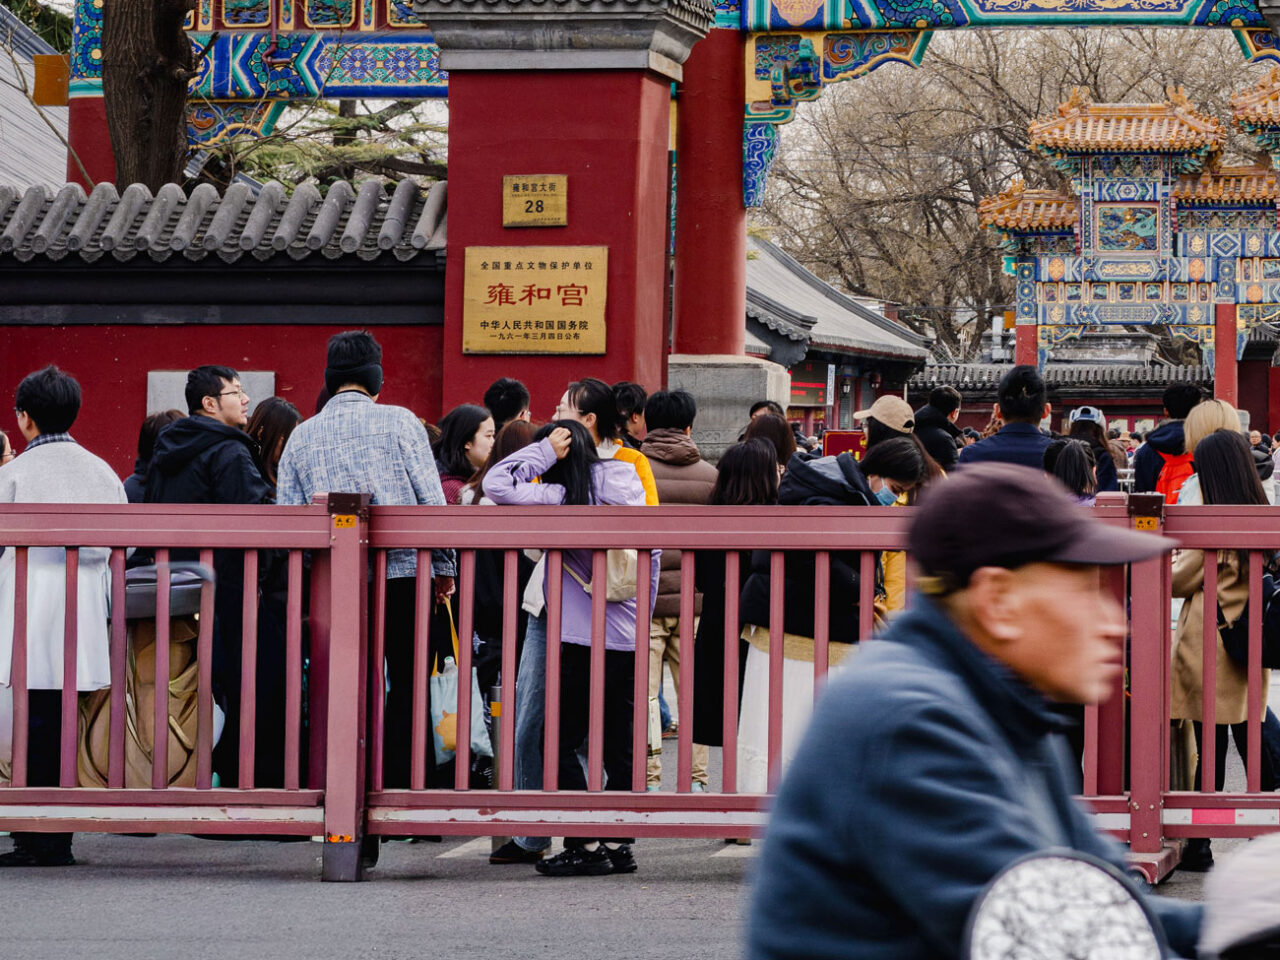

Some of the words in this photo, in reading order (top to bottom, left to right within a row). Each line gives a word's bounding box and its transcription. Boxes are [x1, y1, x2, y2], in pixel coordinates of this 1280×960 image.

[525, 200, 544, 213] 28
[480, 261, 593, 270] 全国重点文物保护单位
[483, 283, 588, 306] 雍和宫
[480, 320, 589, 330] 中华人民共和国国务院
[490, 332, 580, 340] 一九六一年三月四日公布
